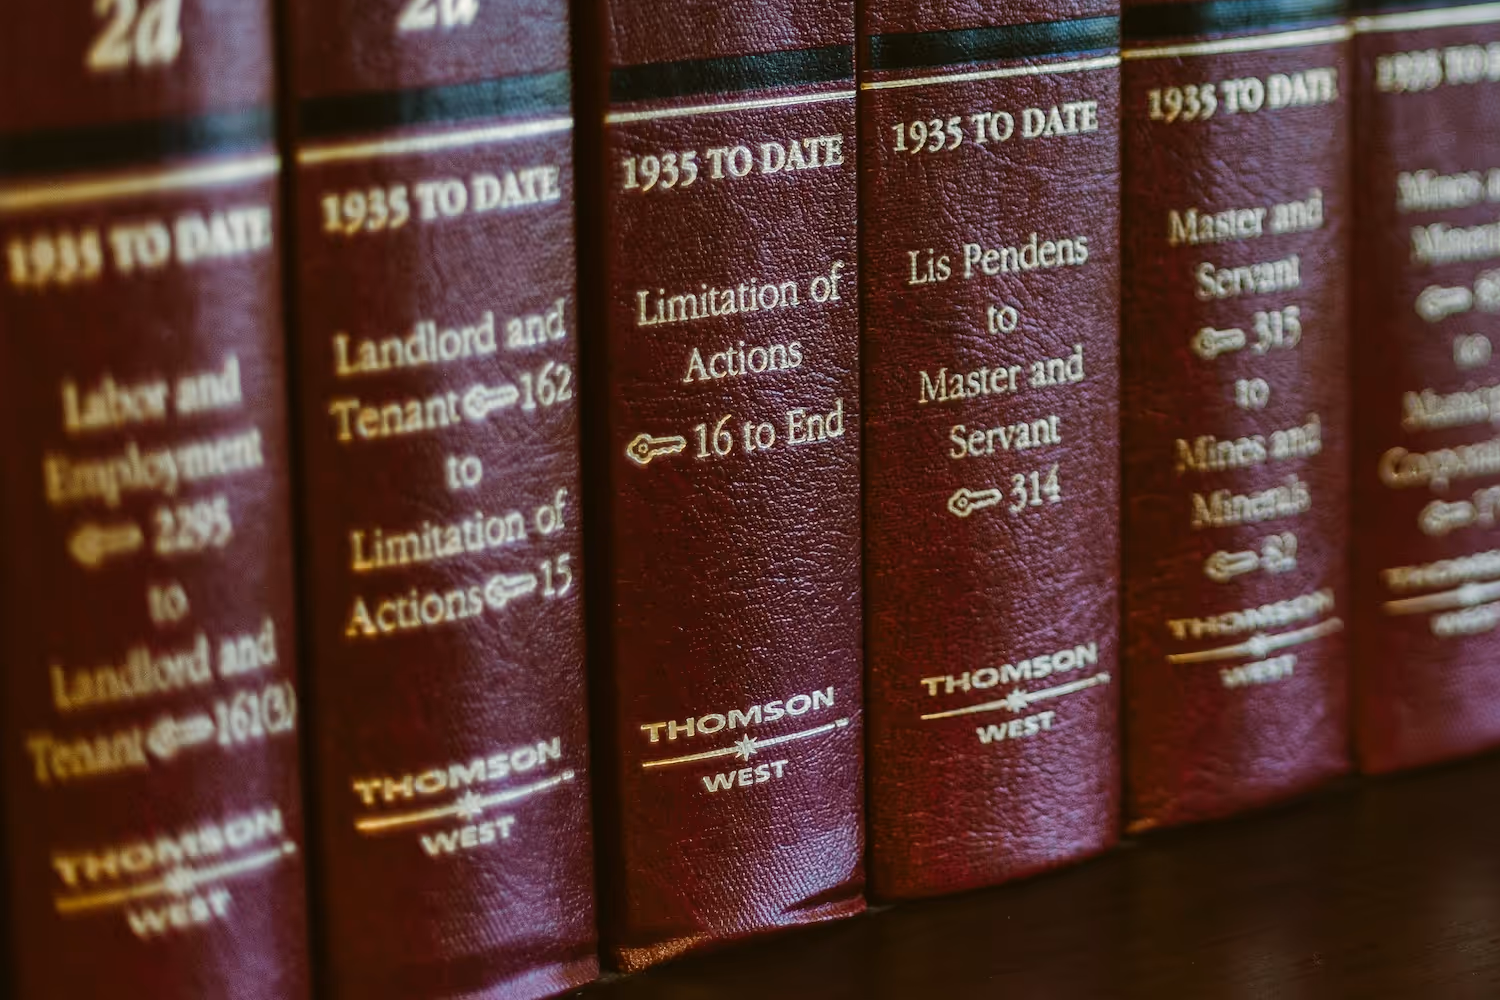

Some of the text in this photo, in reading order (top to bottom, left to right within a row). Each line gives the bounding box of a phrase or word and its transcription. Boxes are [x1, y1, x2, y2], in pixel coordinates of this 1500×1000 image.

[1148, 68, 1339, 122] 1935 TO DATE
[892, 99, 1099, 155] 1935 TO DATE
[622, 133, 846, 193] 1935 TO DATE
[322, 165, 562, 235] 1935 TO DATE
[1168, 188, 1325, 247] Master and
[7, 208, 272, 287] 1935 TO DATE
[907, 231, 1090, 286] Lis Pendens
[636, 260, 846, 328] Limitation of
[1196, 254, 1301, 300] Servant
[333, 299, 567, 376] Landlord and
[987, 303, 1019, 336] to
[1252, 305, 1302, 355] 315
[682, 340, 805, 384] Actions
[918, 346, 1085, 404] Master and
[63, 353, 242, 432] Labor and
[329, 362, 573, 443] Tenant 162
[1235, 377, 1270, 410] to
[694, 401, 846, 460] 16 to End
[948, 415, 1062, 460] Servant
[1175, 412, 1322, 474] Mines and
[44, 428, 263, 504] Employment
[445, 454, 483, 491] to
[1008, 463, 1063, 515] 314
[1192, 474, 1312, 530] Minerals
[351, 490, 569, 572] Limitation of
[149, 584, 189, 625] to
[346, 552, 573, 638] Actions 15
[50, 618, 276, 709] Landlord and
[920, 642, 1098, 698] THOMSON
[641, 685, 836, 743] THOMSON
[975, 710, 1056, 745] WEST
[28, 732, 146, 782] Tenant
[353, 736, 562, 806] THOMSON
[702, 758, 790, 794] WEST
[54, 809, 283, 886] THOMSON
[420, 815, 515, 858] WEST
[129, 889, 231, 940] WEST
